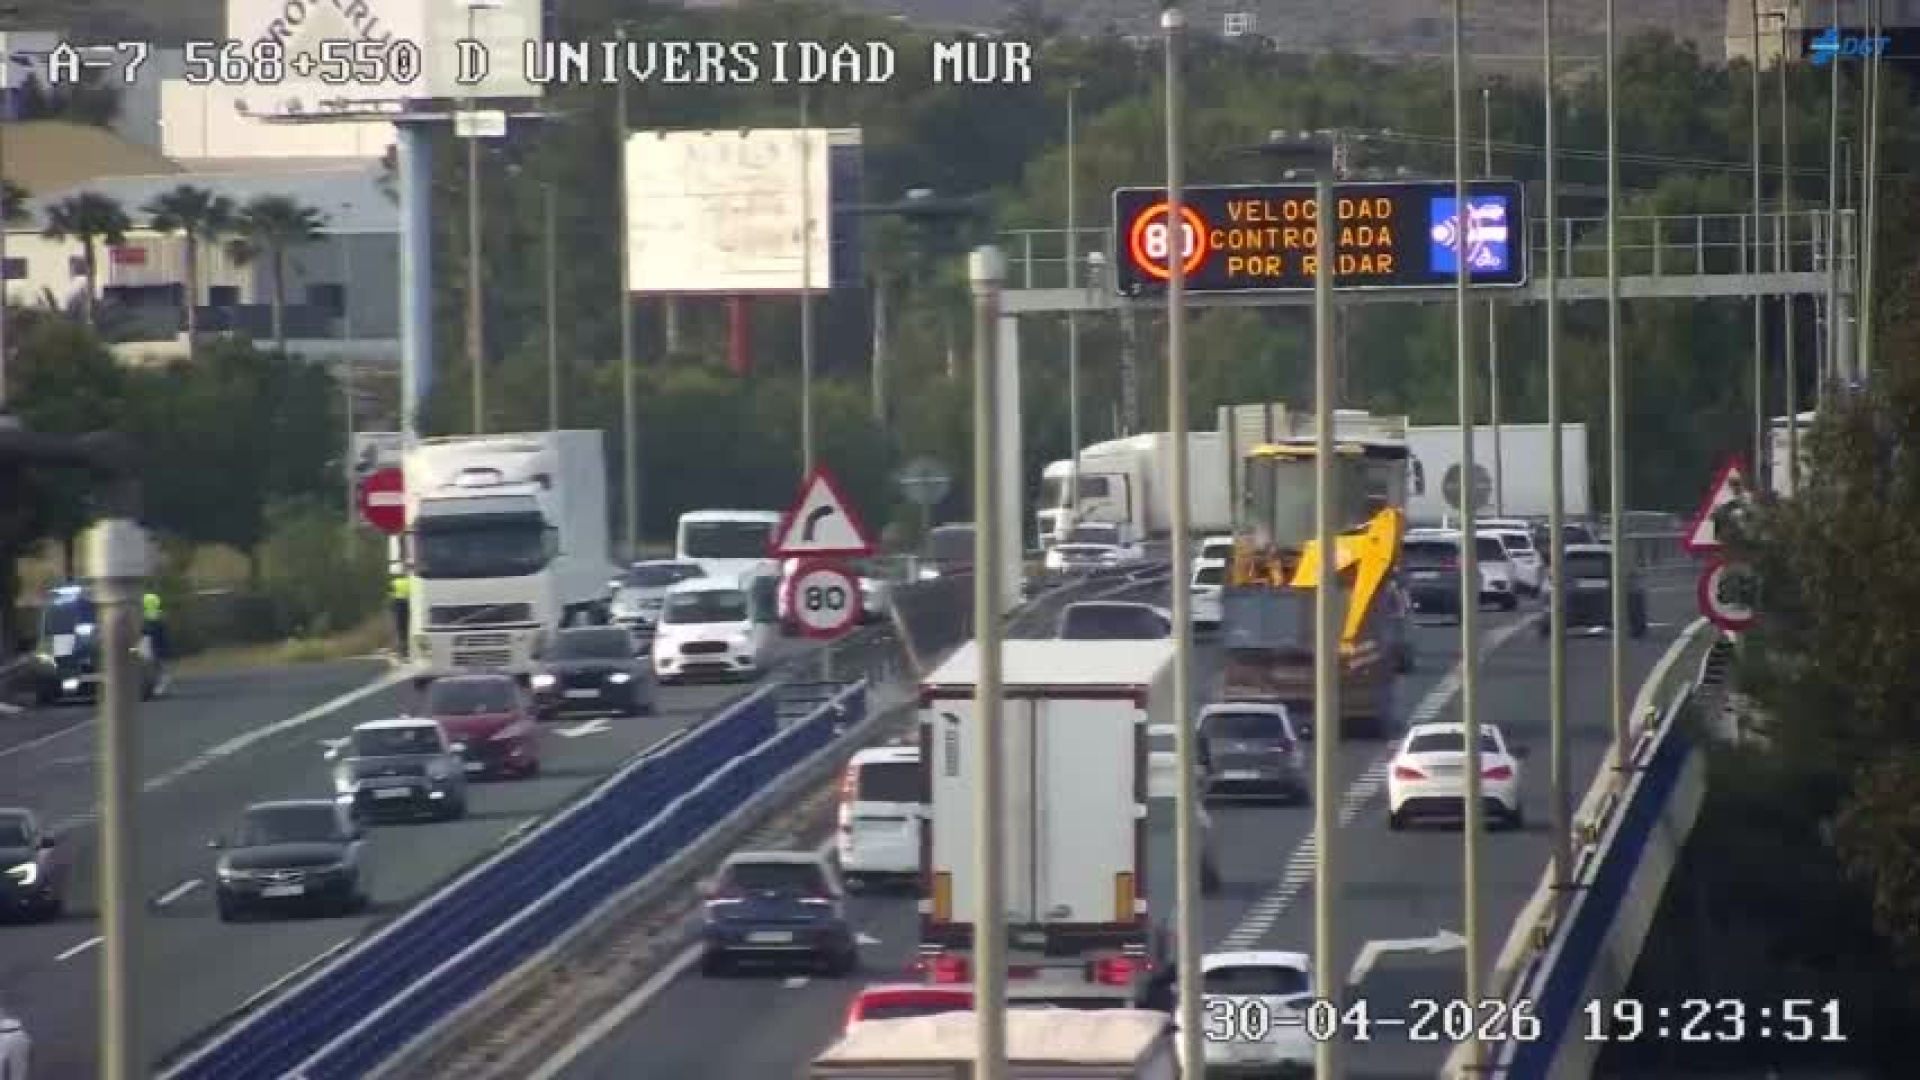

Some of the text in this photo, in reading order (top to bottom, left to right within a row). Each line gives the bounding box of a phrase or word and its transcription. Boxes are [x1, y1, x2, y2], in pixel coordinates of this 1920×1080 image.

[1227, 198, 1393, 222] VELOCDAD
[1210, 226, 1393, 250] CONTROADA
[1228, 253, 1394, 278] POR RDAR
[805, 585, 845, 612] 80
